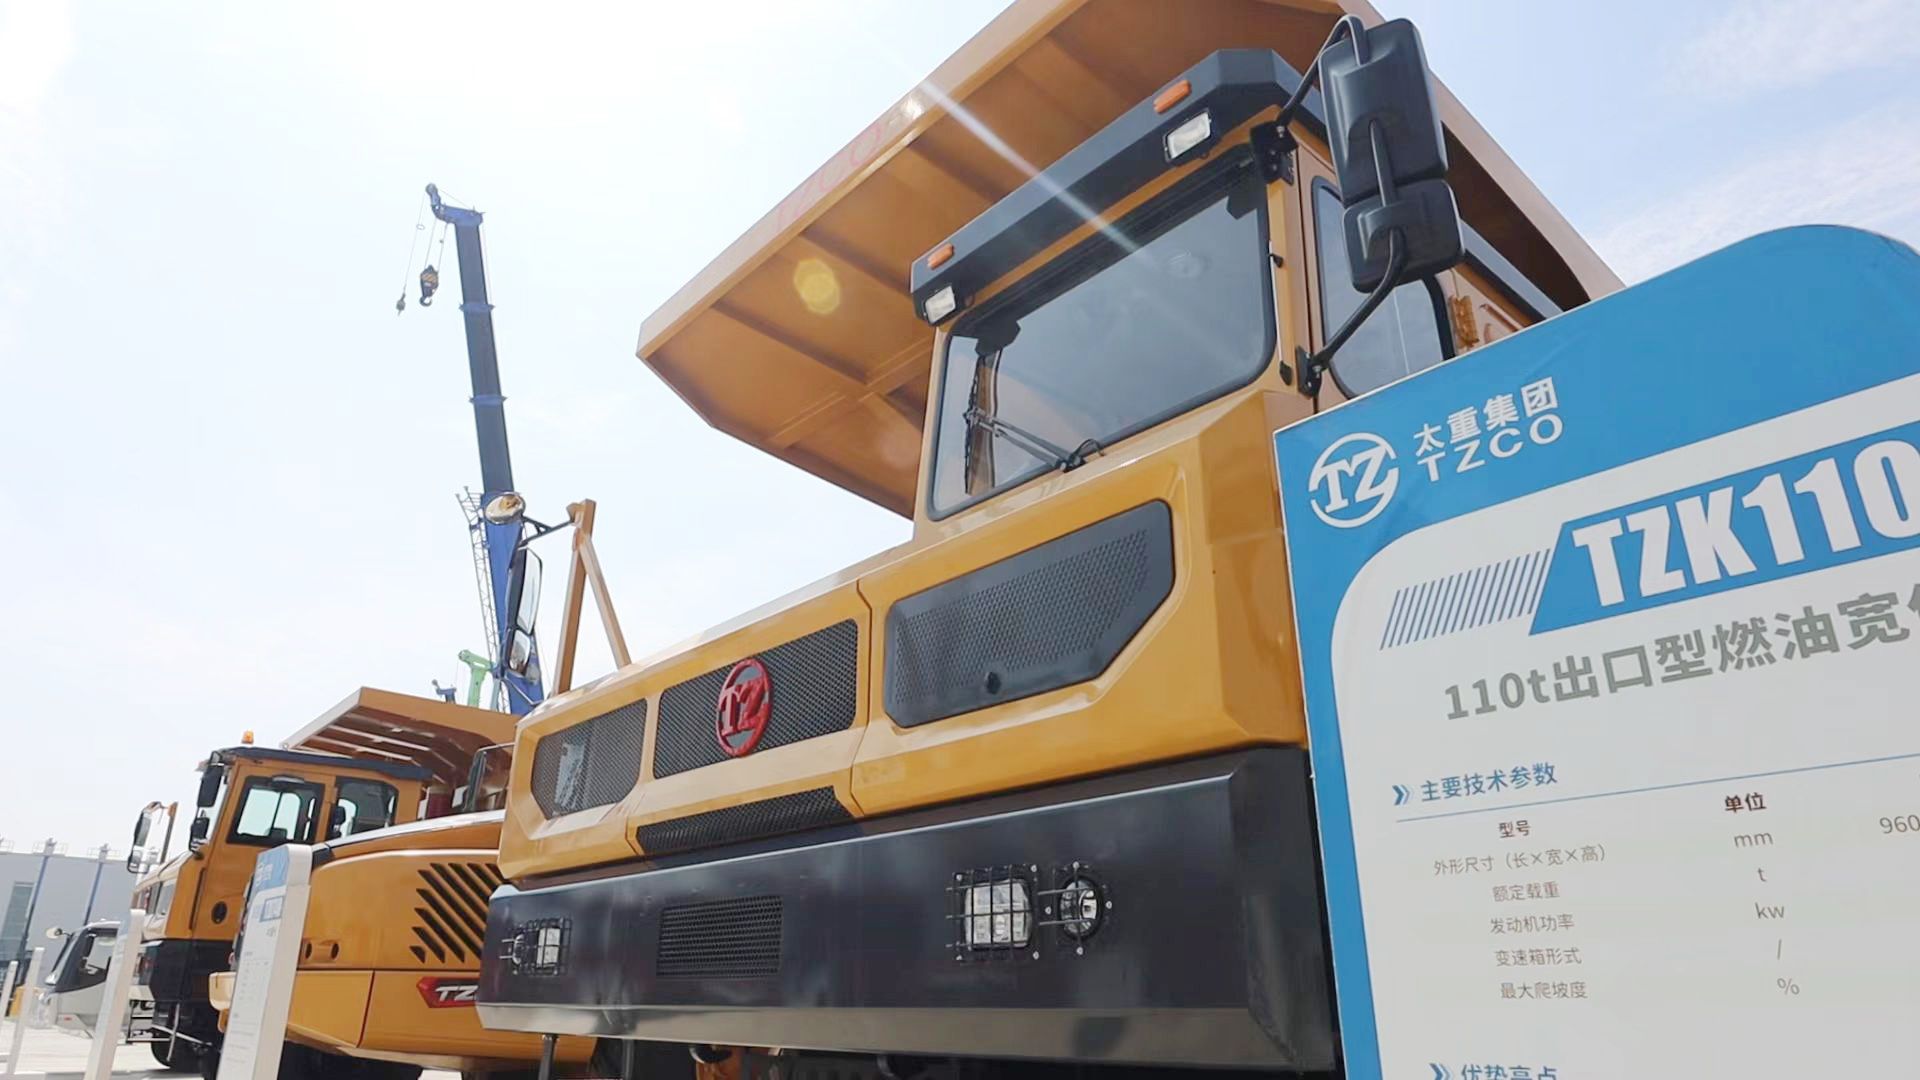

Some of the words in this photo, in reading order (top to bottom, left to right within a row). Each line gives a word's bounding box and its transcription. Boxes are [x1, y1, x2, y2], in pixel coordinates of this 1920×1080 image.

[1413, 376, 1558, 456] 太重集团
[1417, 414, 1563, 482] TZCO
[1310, 446, 1398, 514] TZ
[1571, 440, 1920, 607] TZK110
[1444, 583, 1920, 720] 110t出口型燃油宽
[1420, 761, 1558, 802] 主要技术参数
[1498, 820, 1531, 839] 型号
[1724, 792, 1767, 813] 单位
[1734, 832, 1773, 848] mm
[1879, 814, 1920, 834] 960
[1492, 880, 1560, 902] 额定载重
[1757, 868, 1767, 882] t
[1490, 913, 1575, 934] 发动机功率
[1494, 947, 1582, 967] 变速箱形式
[1500, 981, 1588, 1000] 最大爬坡度
[1776, 977, 1800, 995] %
